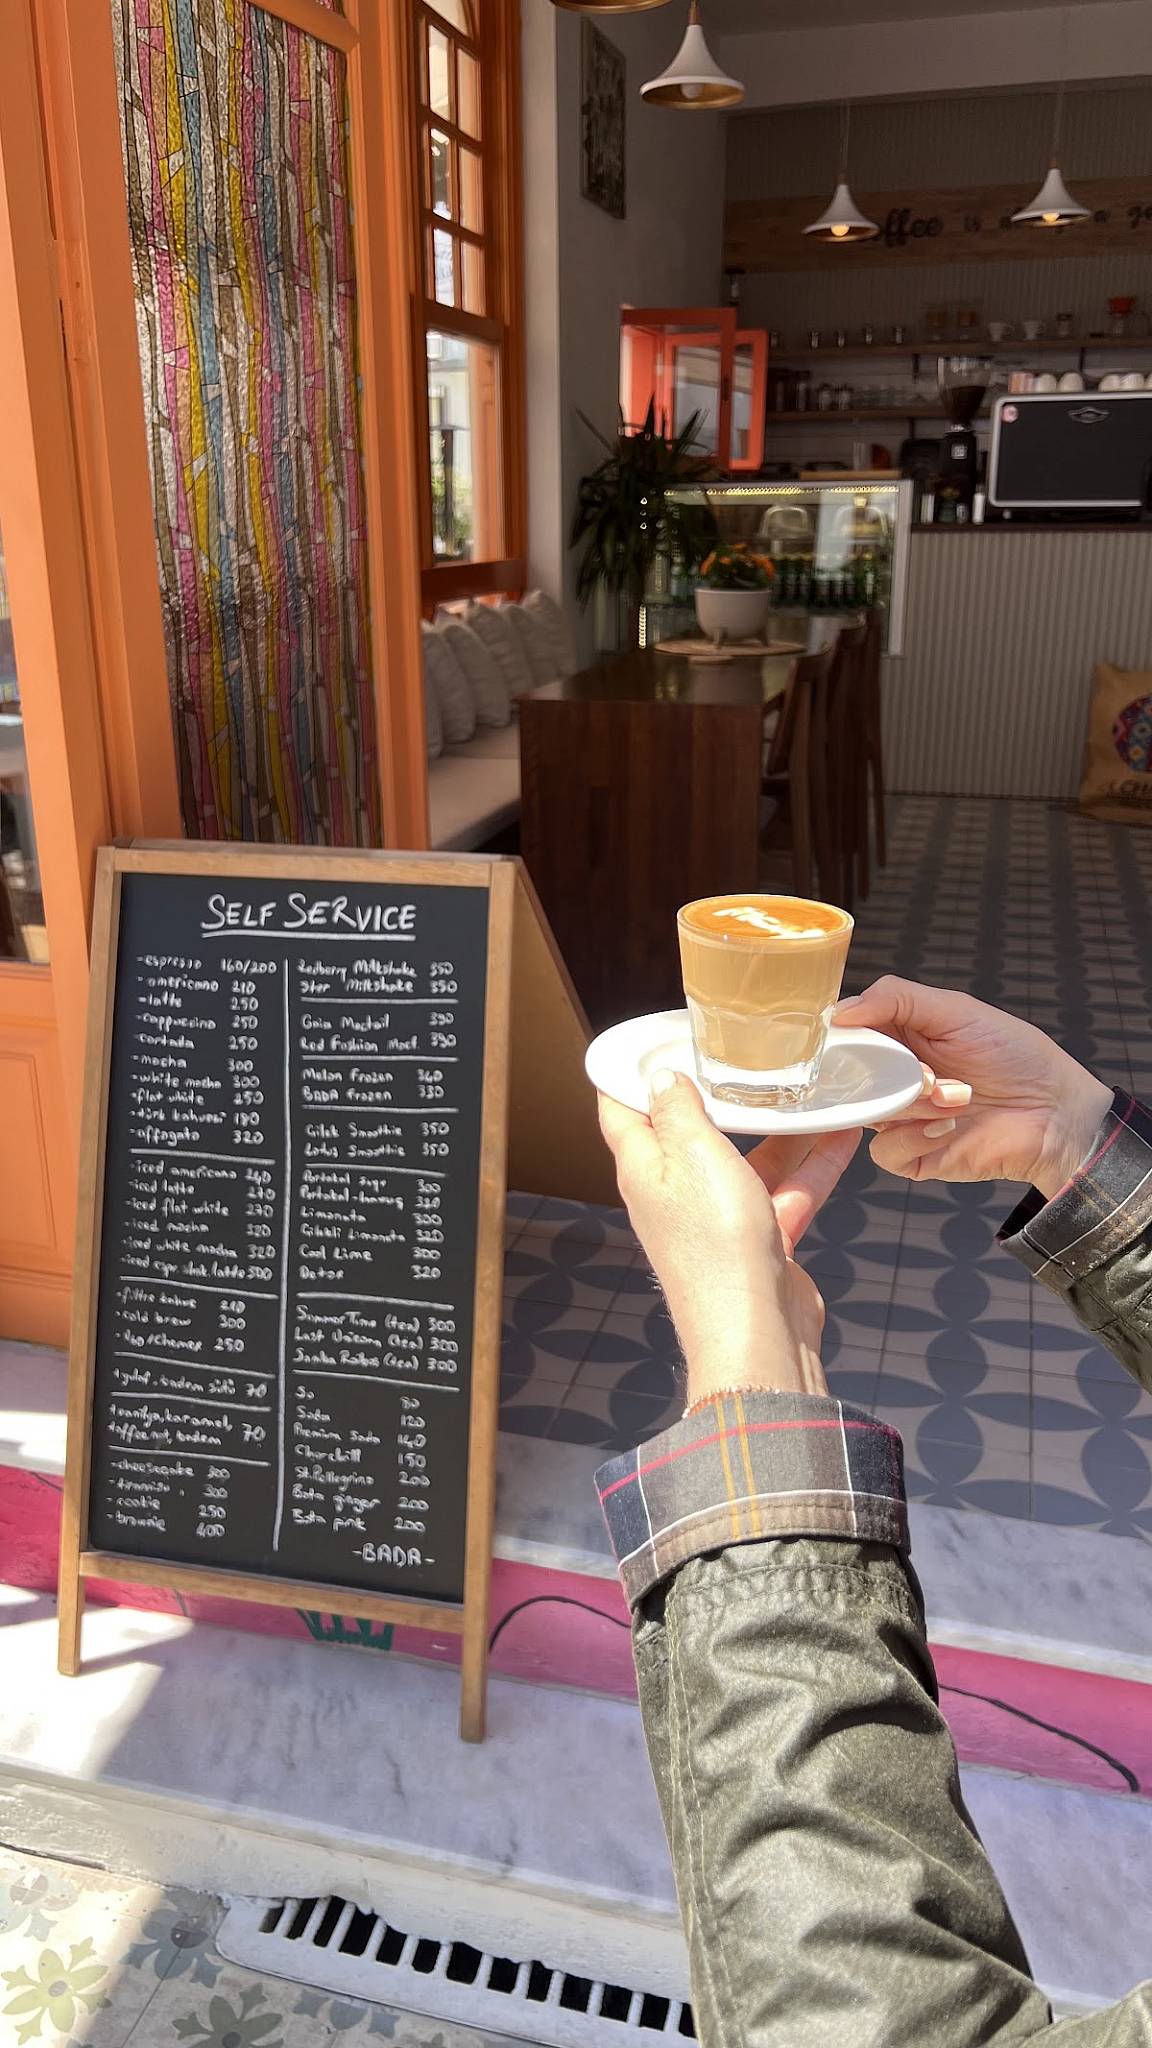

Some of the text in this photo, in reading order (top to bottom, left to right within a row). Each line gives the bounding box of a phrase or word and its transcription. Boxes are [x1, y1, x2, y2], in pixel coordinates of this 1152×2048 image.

[201, 892, 417, 932] SELF SERVICE
[220, 957, 278, 974] 160/200
[231, 980, 256, 995] 210
[230, 996, 259, 1011] 250
[232, 1014, 259, 1030] 250
[228, 1035, 258, 1050] 250
[226, 1058, 254, 1073] 300
[185, 1076, 222, 1089] mocha
[232, 1074, 260, 1089] 300
[168, 1089, 205, 1106] white
[233, 1090, 265, 1106] 250
[302, 1085, 339, 1102] BADA
[232, 1129, 265, 1145] 320
[348, 1121, 402, 1138] Smoothie
[420, 1121, 450, 1137] 350
[347, 1143, 406, 1158] Smoothie
[162, 1178, 195, 1195] latte
[161, 1197, 189, 1218] flat
[192, 1200, 230, 1216] white
[412, 1212, 443, 1227] 300
[300, 1243, 327, 1260] Cool
[333, 1246, 374, 1262] Lime
[218, 1314, 246, 1330] 300
[427, 1316, 456, 1333] 300
[213, 1336, 245, 1352] 250
[429, 1336, 459, 1353] 300
[426, 1357, 458, 1374] 300
[241, 1422, 267, 1442] 70
[398, 1452, 427, 1468] 150
[398, 1471, 431, 1488] 200
[198, 1503, 226, 1519] 250
[196, 1522, 226, 1538] 400
